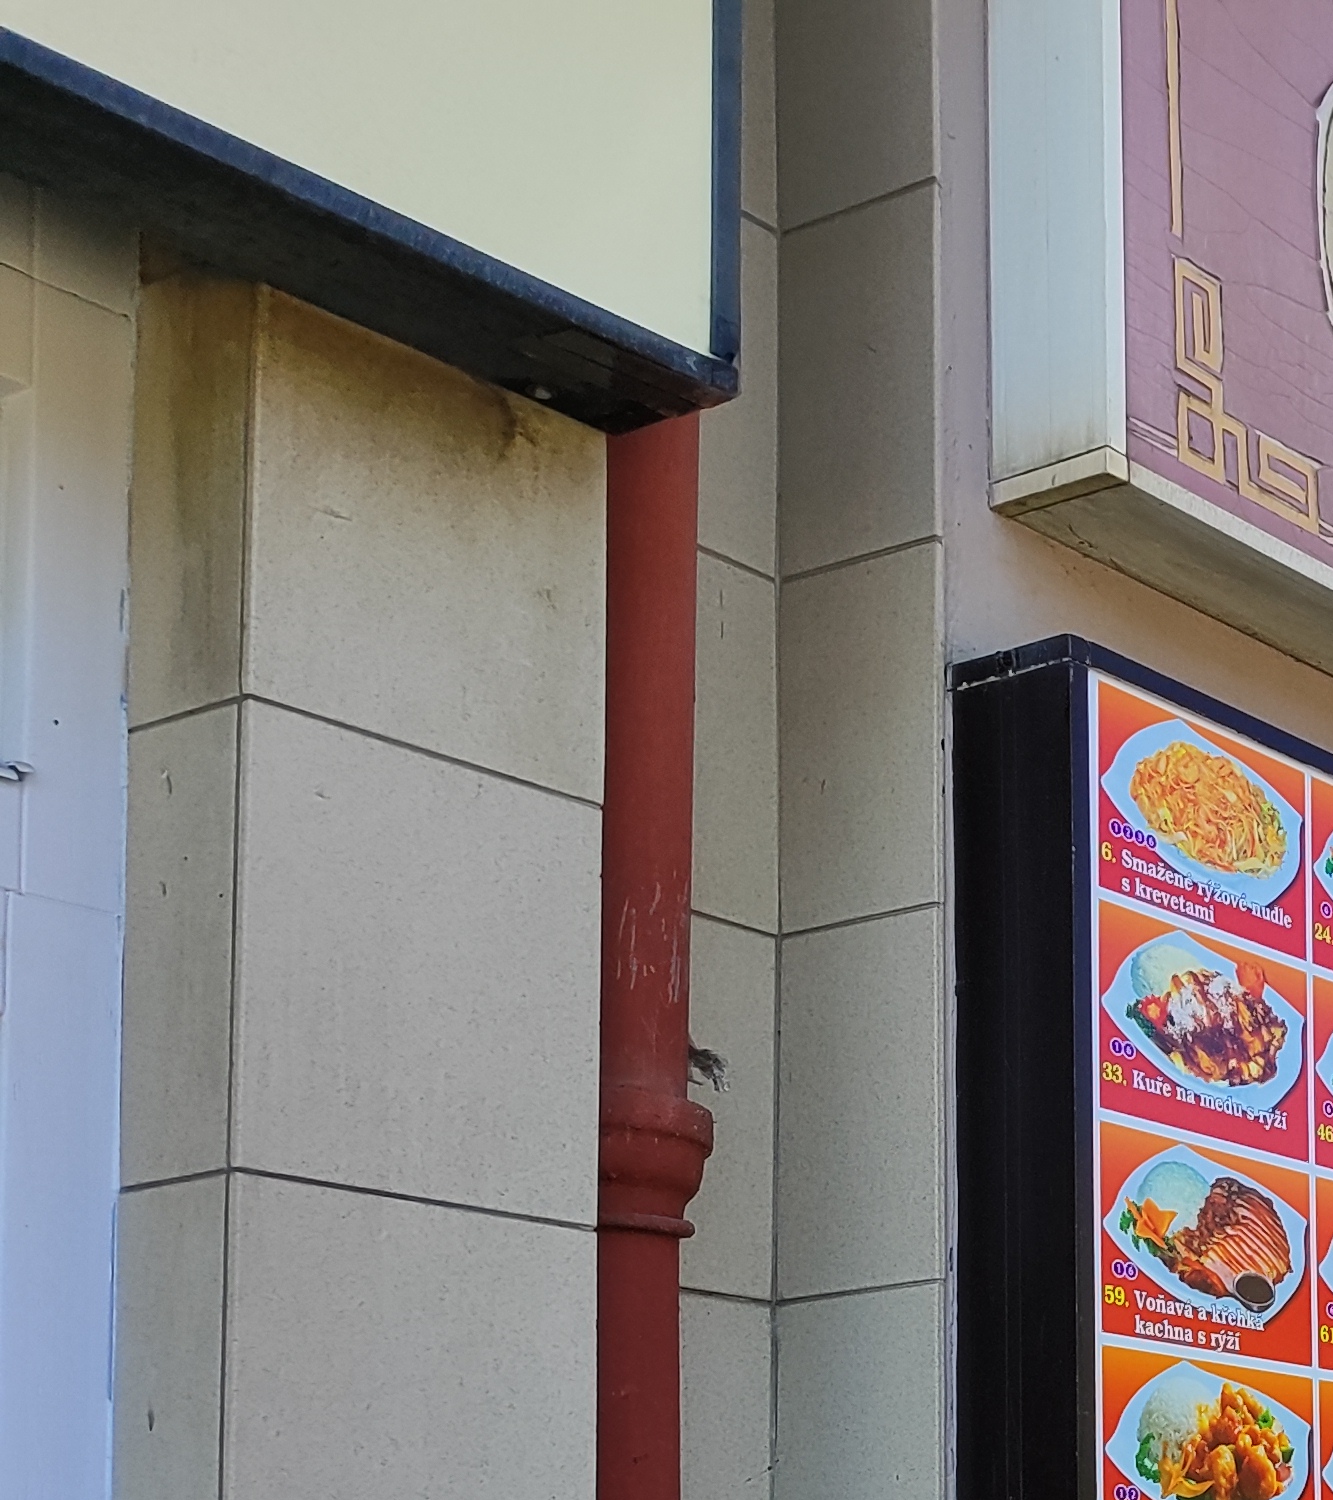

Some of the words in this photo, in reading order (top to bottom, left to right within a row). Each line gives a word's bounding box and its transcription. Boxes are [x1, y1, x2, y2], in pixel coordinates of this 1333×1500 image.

[1102, 842, 1116, 863] 6.
[1121, 849, 1193, 891] Smažené
[1251, 901, 1292, 928] nudle
[1121, 879, 1130, 892] s
[1135, 878, 1215, 923] krevetami
[1102, 1062, 1127, 1086] 33.
[1133, 1069, 1172, 1097] Kuře
[1176, 1086, 1195, 1104] na
[1200, 1093, 1242, 1118] medu
[1247, 1107, 1254, 1121] s
[1257, 1109, 1287, 1130] rýží
[1104, 1284, 1129, 1307] 59.
[1134, 1290, 1193, 1320] Voňavá
[1199, 1307, 1208, 1321] a
[1211, 1304, 1264, 1331] křehká
[1134, 1315, 1193, 1343] kachna
[1198, 1331, 1206, 1345] s
[1211, 1330, 1240, 1352] rýží
